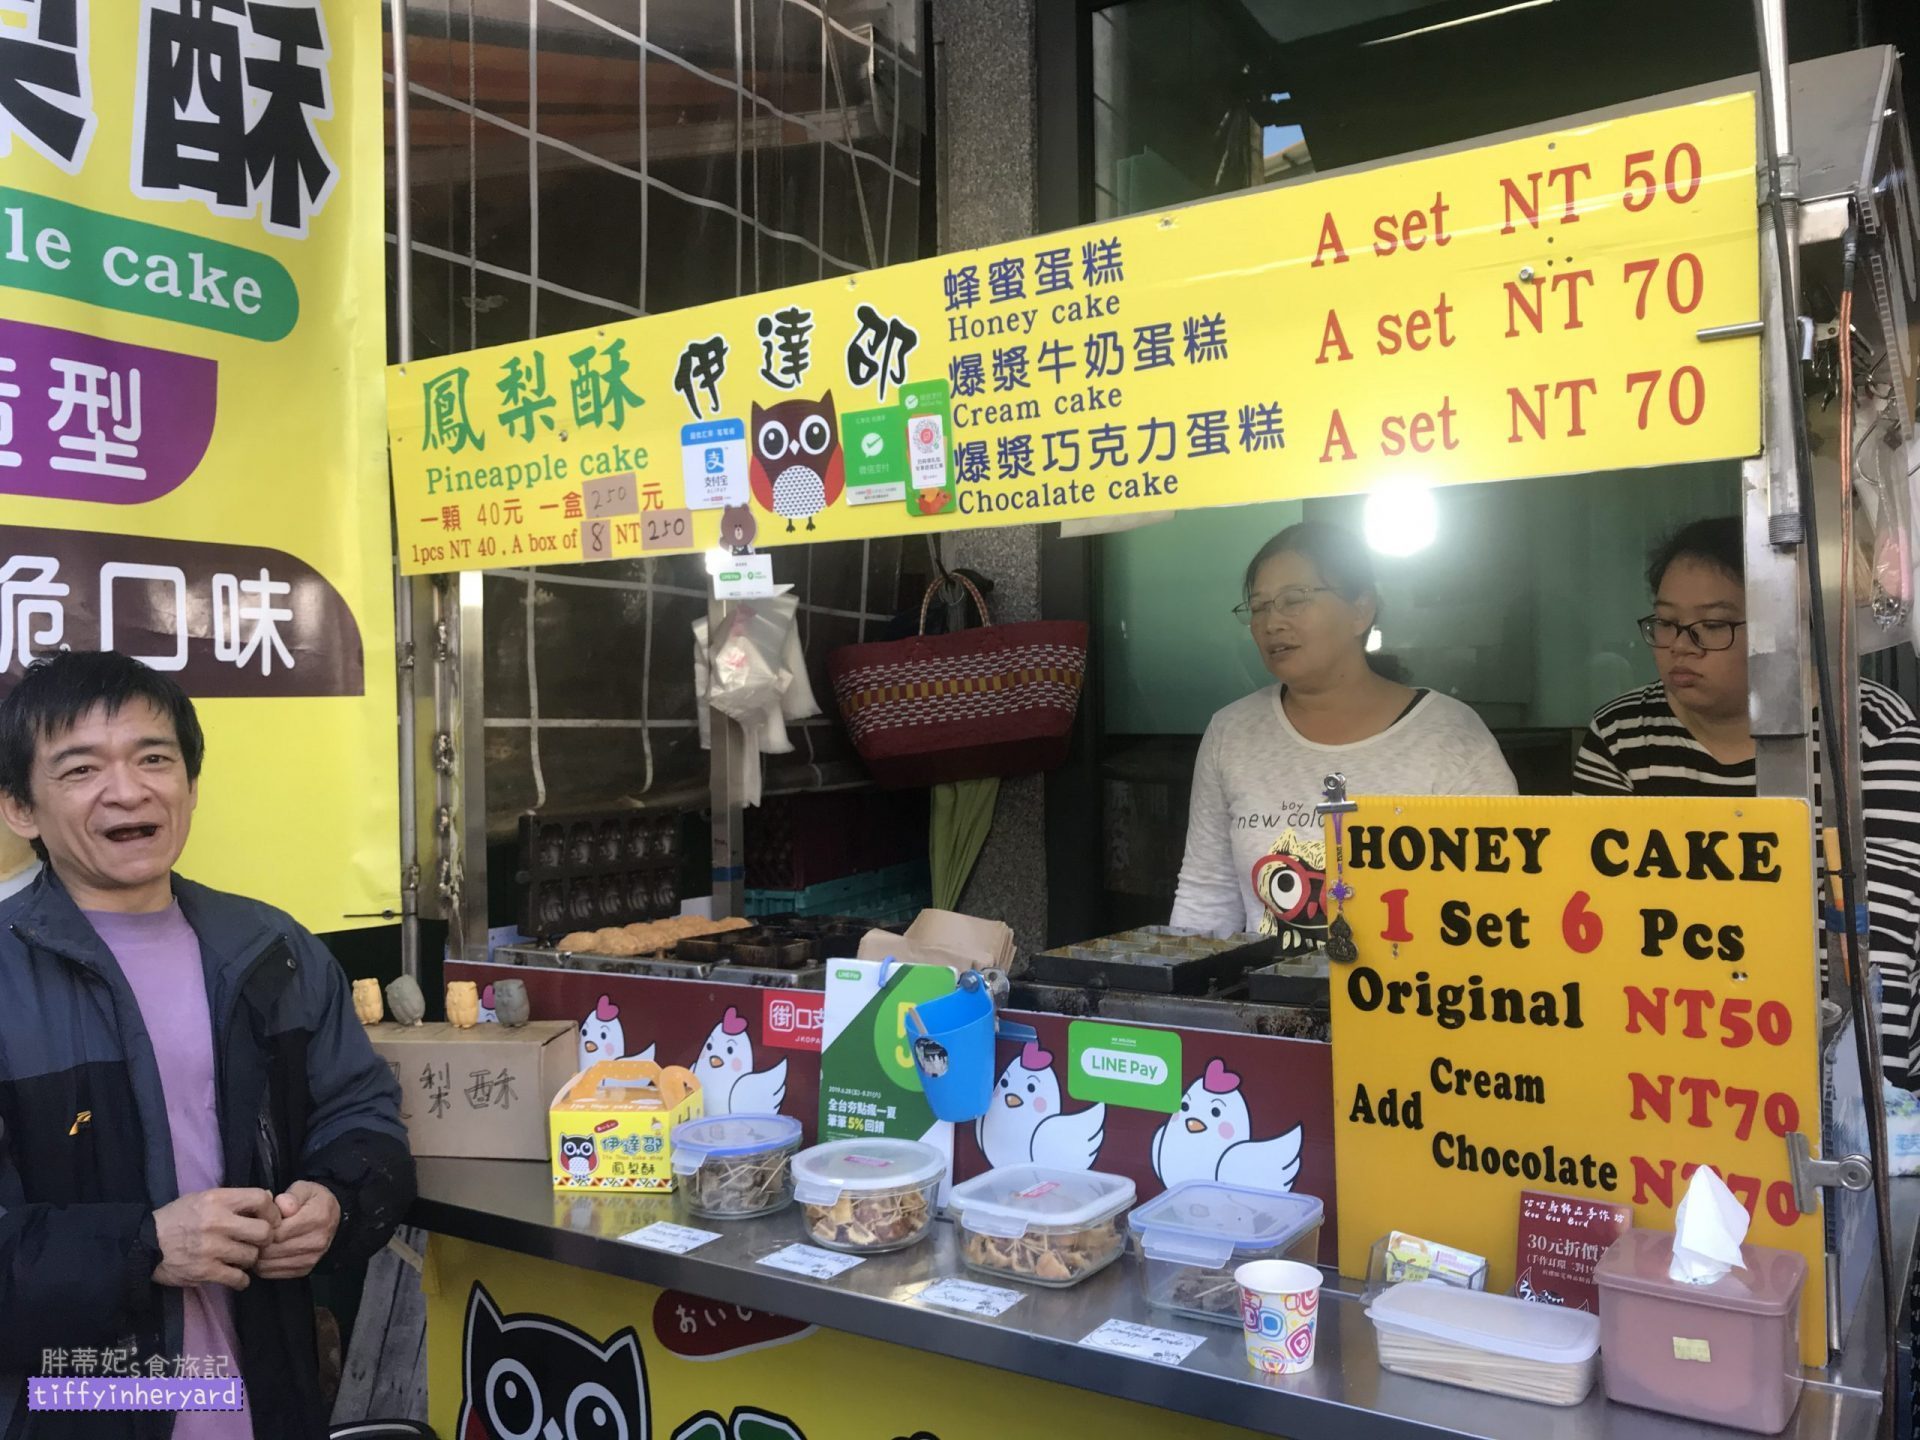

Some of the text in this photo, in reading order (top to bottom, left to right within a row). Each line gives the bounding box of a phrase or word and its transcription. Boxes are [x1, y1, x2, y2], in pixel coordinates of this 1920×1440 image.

[1311, 142, 1702, 268] A set NT 50
[102, 245, 263, 315] cake
[944, 237, 1124, 312] 蜂蜜蛋糕
[948, 294, 1120, 341] Honey cake
[1315, 253, 1704, 364] A set NT 70
[674, 305, 918, 420] 伊達邵
[949, 312, 1228, 399] 爆漿牛奶蛋糕
[0, 357, 147, 480] 型
[421, 338, 645, 454] 鳳梨酥
[953, 386, 1122, 428] Cream cake
[1319, 366, 1705, 463] A set NT 70
[426, 445, 649, 494] Pineapple cake
[954, 401, 1285, 484] 爆漿巧克力蛋糕
[704, 475, 729, 488] 支付宝
[959, 472, 1179, 514] Chocalate cake
[412, 543, 444, 566] 1pcs
[450, 539, 471, 559] NT
[512, 535, 524, 554] A
[529, 533, 557, 556] box
[563, 529, 578, 549] of
[591, 521, 604, 552] 8
[616, 523, 640, 544] NT
[647, 519, 685, 541] 250
[1237, 813, 1280, 829] new
[1281, 801, 1304, 812] boy
[1348, 826, 1782, 883] HONEY CAKE
[1380, 888, 1746, 962] 1 Set 6 Pcs
[1347, 966, 1793, 1048] Original NT50
[1091, 1055, 1158, 1080] LINE Pay
[1430, 1057, 1800, 1141] Cream NT70
[1349, 1083, 1424, 1130] Add
[612, 1161, 656, 1175] 鳳梨酥
[1432, 1131, 1618, 1192] Chocolate
